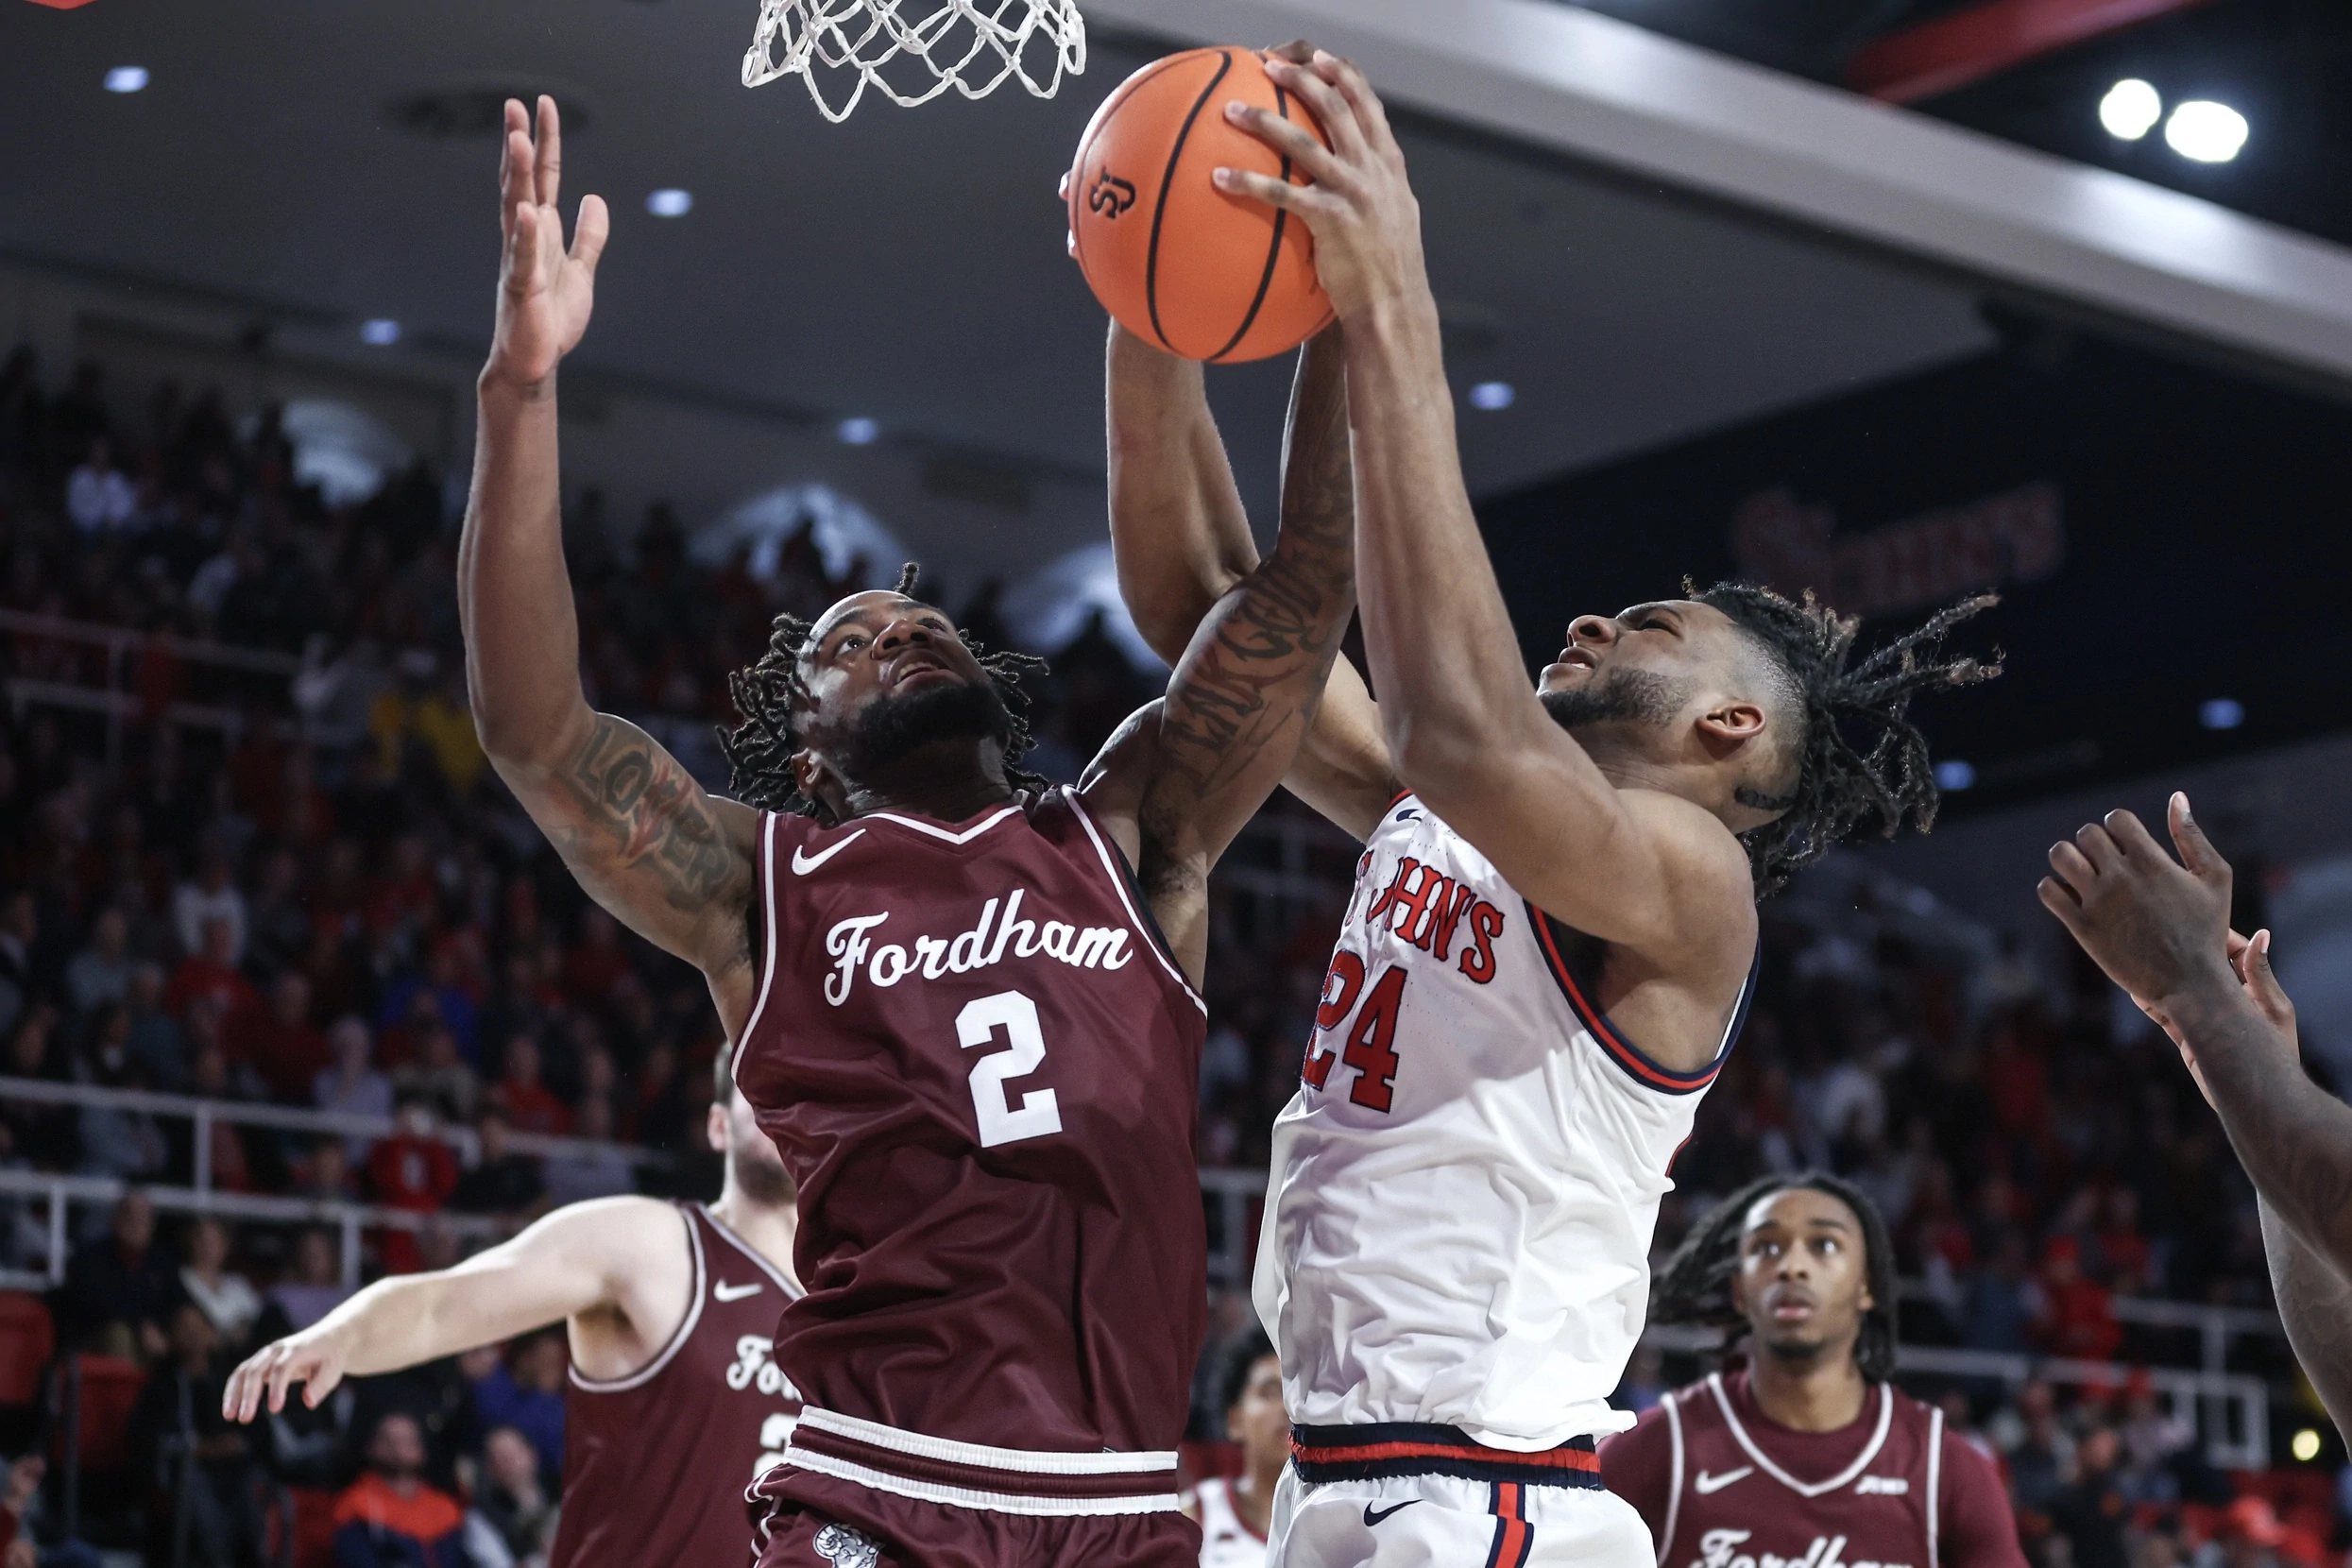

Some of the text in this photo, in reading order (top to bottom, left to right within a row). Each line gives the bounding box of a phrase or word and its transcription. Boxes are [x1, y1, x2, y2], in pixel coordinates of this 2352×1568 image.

[824, 887, 1133, 1007] Fordham
[954, 989, 1064, 1149] 2
[1301, 947, 1408, 1115] 24
